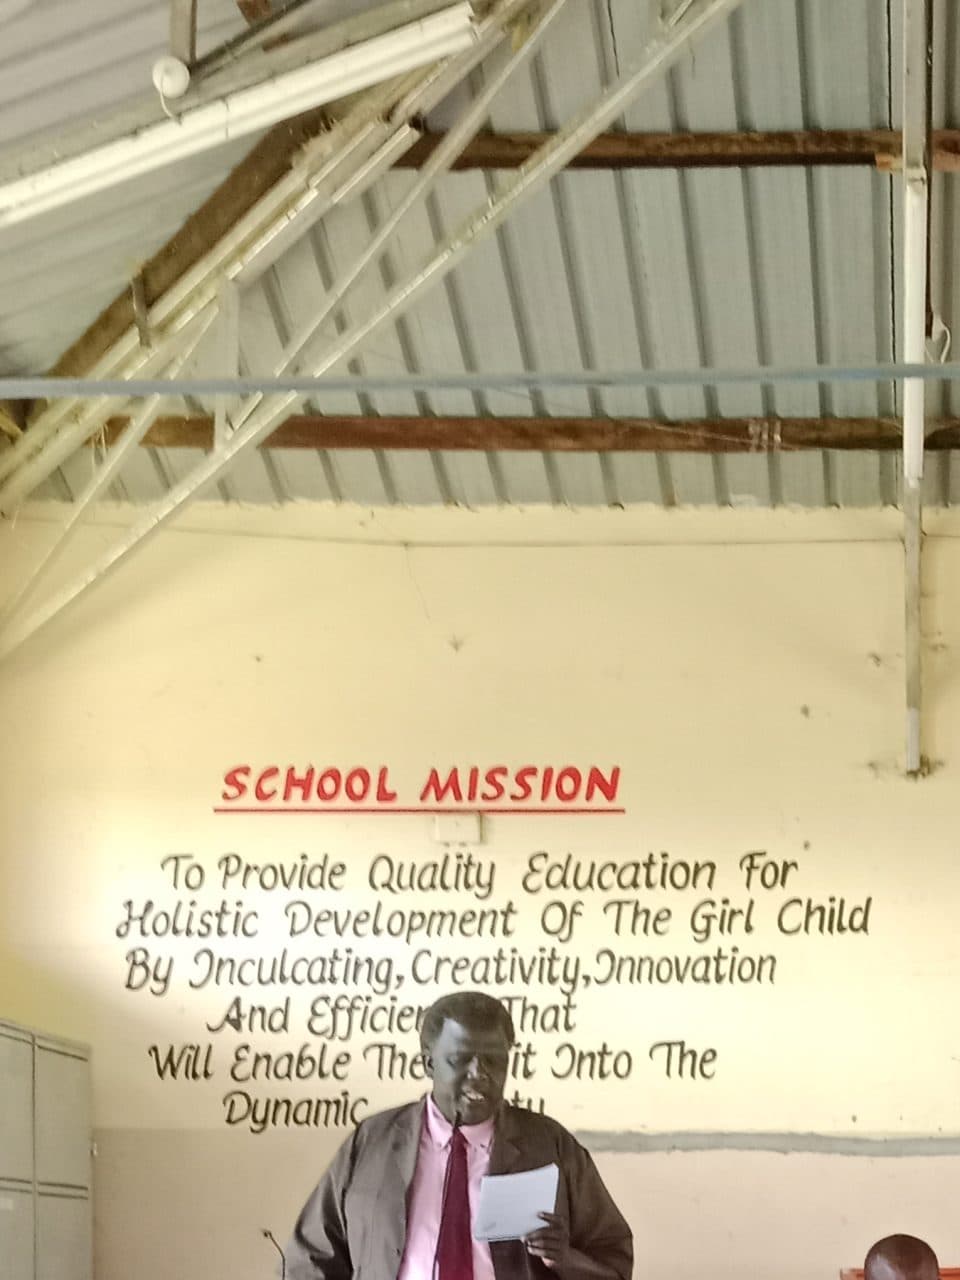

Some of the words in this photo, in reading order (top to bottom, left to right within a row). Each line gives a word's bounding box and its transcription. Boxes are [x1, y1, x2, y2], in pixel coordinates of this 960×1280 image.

[223, 766, 397, 802] SCHOOL
[420, 766, 621, 801] MISSION
[161, 854, 205, 891] To
[218, 853, 346, 891] Provide
[369, 853, 495, 899] Quality
[522, 851, 716, 893] Education
[739, 851, 798, 891] For
[116, 900, 258, 939] Holistic
[284, 899, 517, 945] Development
[541, 900, 584, 943] Of
[603, 899, 672, 936] The
[690, 898, 754, 942] Girl
[777, 896, 872, 936] Child
[125, 947, 174, 997] By
[206, 996, 290, 1033] And
[148, 1043, 214, 1080] Will
[230, 1043, 352, 1082] Enable
[511, 1042, 537, 1080] it
[551, 1042, 632, 1080] Into
[649, 1040, 718, 1080] The
[223, 1090, 369, 1134] Dynamic
